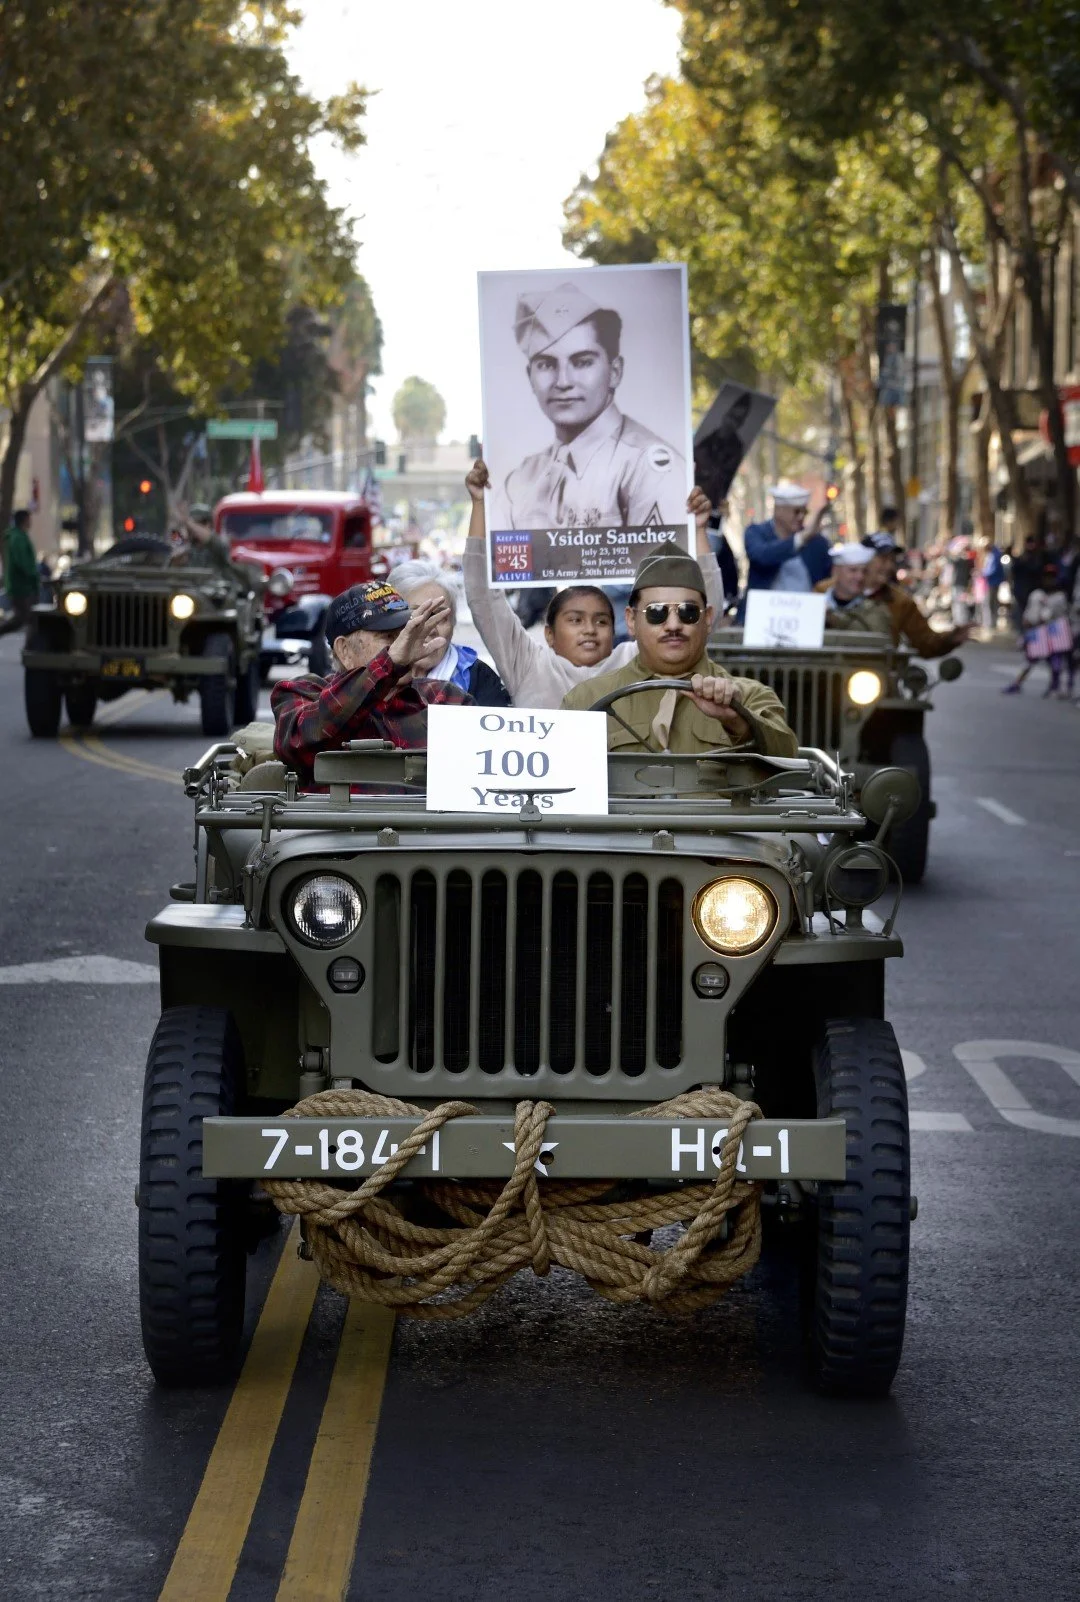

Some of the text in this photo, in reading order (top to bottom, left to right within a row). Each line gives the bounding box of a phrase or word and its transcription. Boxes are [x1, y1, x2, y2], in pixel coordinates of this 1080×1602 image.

[496, 534, 529, 543] KEEP THE
[546, 527, 677, 547] Ysidor Sanchez
[497, 545, 528, 554] SPIRIT
[581, 547, 629, 557] July 23, 1921
[598, 558, 617, 567] Jose,
[618, 557, 632, 565] CA
[497, 572, 531, 581] ALIVE!
[542, 569, 555, 578] US
[556, 569, 578, 578] Army
[584, 568, 602, 576] 30th
[603, 566, 636, 577] Infantry
[479, 714, 555, 740] Only
[476, 749, 550, 778] 100
[671, 1128, 790, 1174] HQ-1
